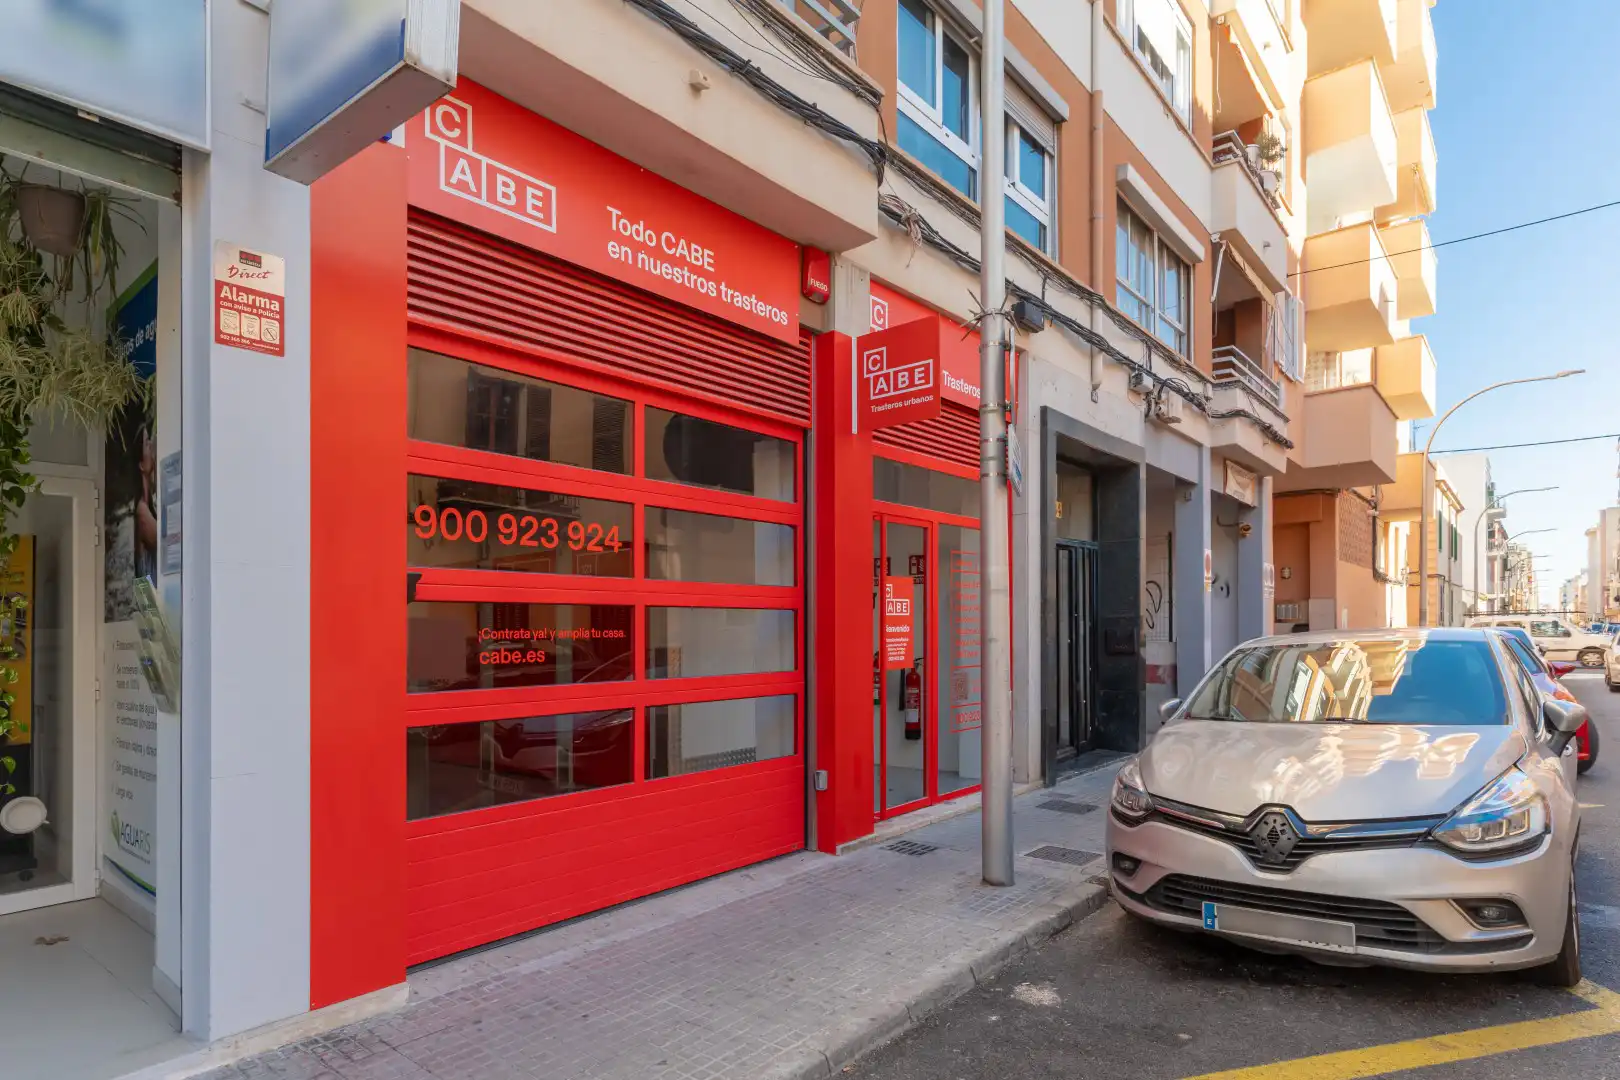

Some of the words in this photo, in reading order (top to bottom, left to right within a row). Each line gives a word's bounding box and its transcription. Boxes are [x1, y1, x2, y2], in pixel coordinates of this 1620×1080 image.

[606, 206, 657, 248] Todo
[661, 230, 715, 272] CABE
[228, 265, 272, 279] Direct
[607, 241, 633, 265] en
[637, 250, 717, 297] nuestros
[720, 281, 789, 326] trasteros
[810, 278, 828, 292] FUEGO
[220, 285, 280, 312] Alarma
[220, 300, 233, 308] con
[234, 303, 252, 312] aviso
[136, 327, 144, 347] de
[942, 369, 980, 399] Trasteros
[871, 401, 903, 413] Trasteros
[904, 395, 934, 406] urbanos
[414, 504, 488, 543] 900
[498, 513, 560, 549] 923
[567, 521, 622, 553] 924
[478, 627, 531, 644] ¡Contrata
[533, 627, 547, 641] ya!
[550, 629, 555, 641] y
[591, 627, 601, 638] tu
[603, 629, 626, 638] casa.
[479, 648, 545, 665] cabe.es
[121, 821, 151, 855] AGUARIS
